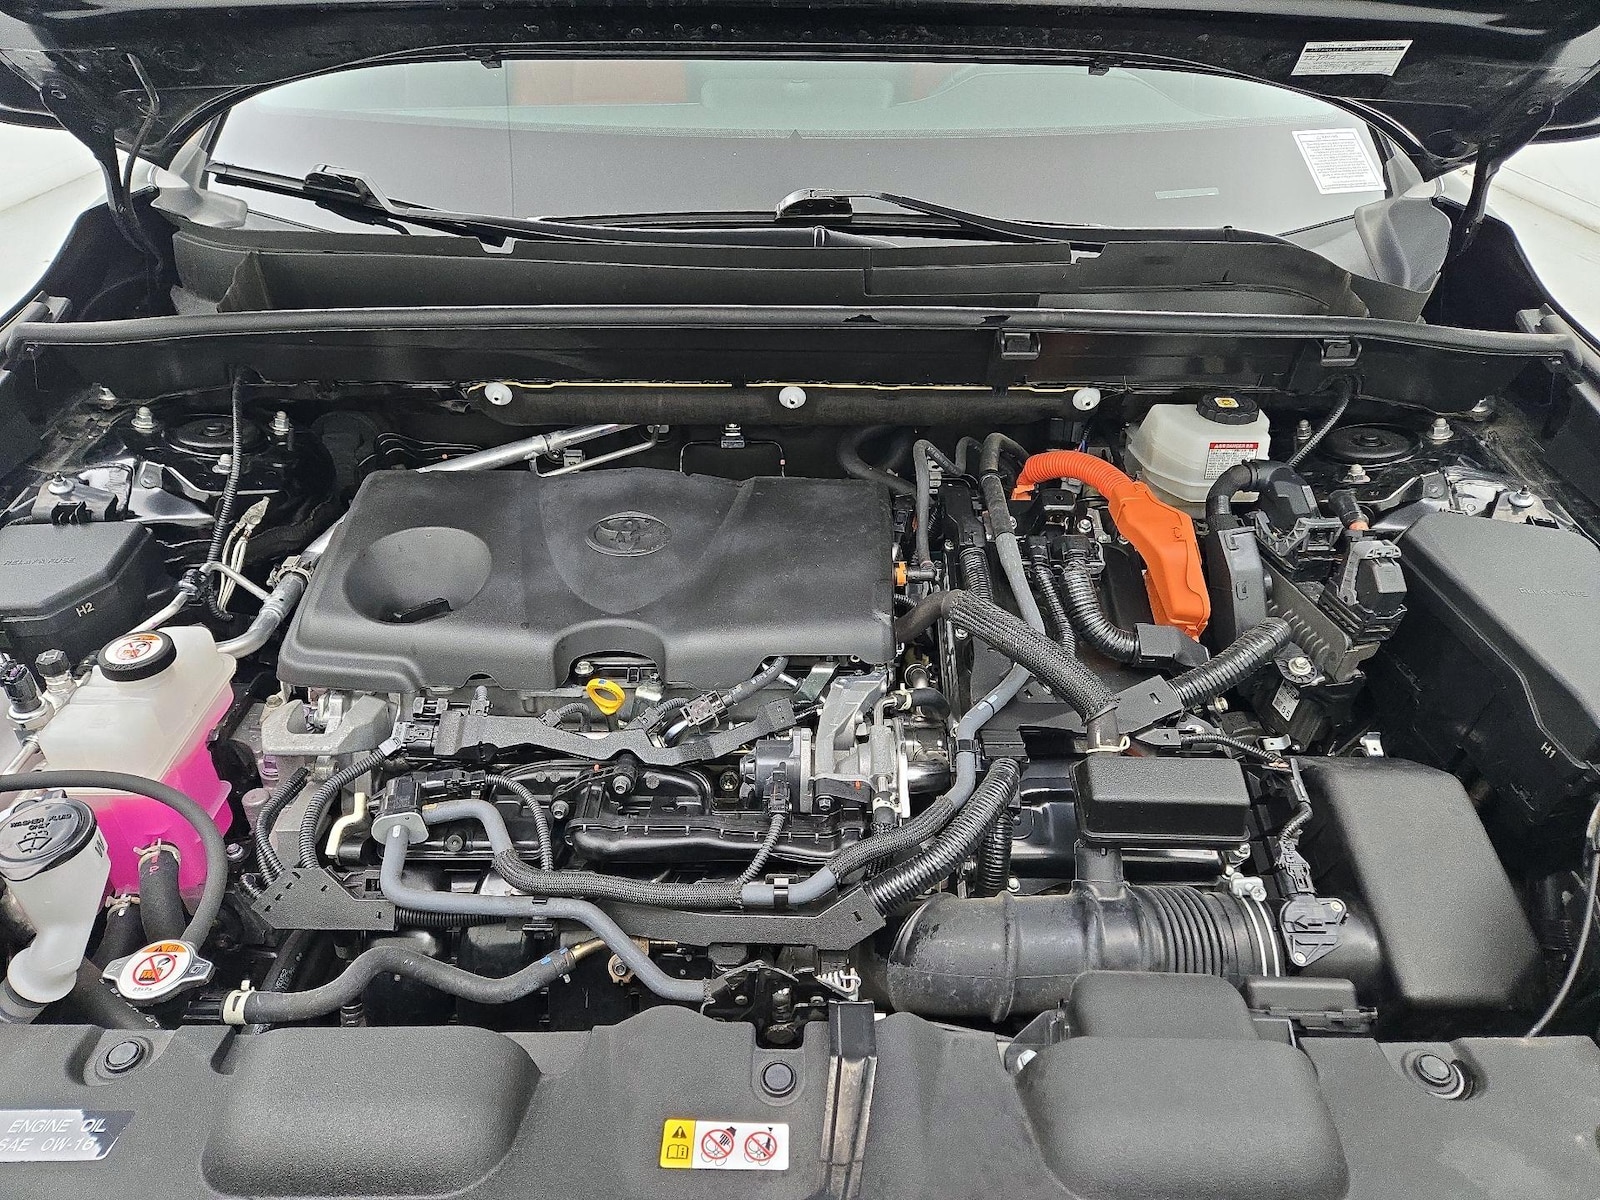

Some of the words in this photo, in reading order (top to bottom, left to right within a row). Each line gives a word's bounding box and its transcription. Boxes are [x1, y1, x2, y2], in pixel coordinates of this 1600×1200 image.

[75, 602, 95, 617] H2
[1540, 741, 1557, 759] H1
[10, 817, 45, 829] WASHER
[48, 814, 72, 822] FLUID
[28, 822, 51, 831] ONLY
[7, 1119, 74, 1133] ENGINE
[80, 1118, 107, 1133] OIL
[0, 1137, 35, 1152] SAE
